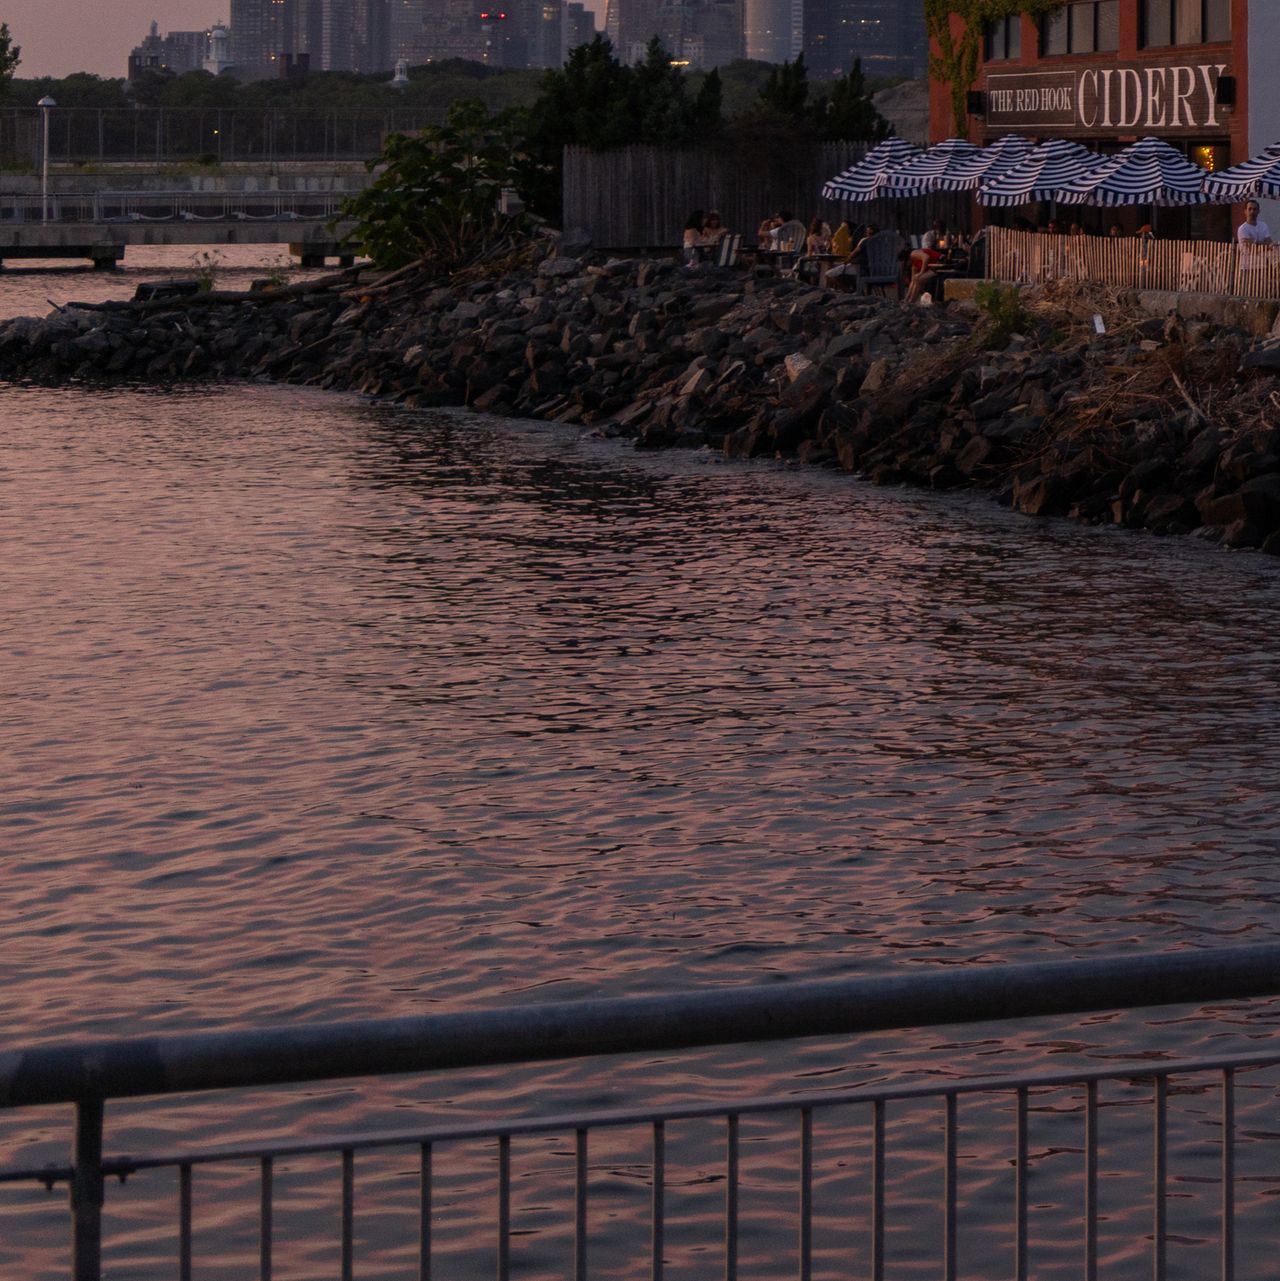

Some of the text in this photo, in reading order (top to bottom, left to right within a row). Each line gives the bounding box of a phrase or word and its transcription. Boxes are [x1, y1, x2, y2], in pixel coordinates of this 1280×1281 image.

[990, 64, 1227, 128] THE RED HOOK CIDERY
